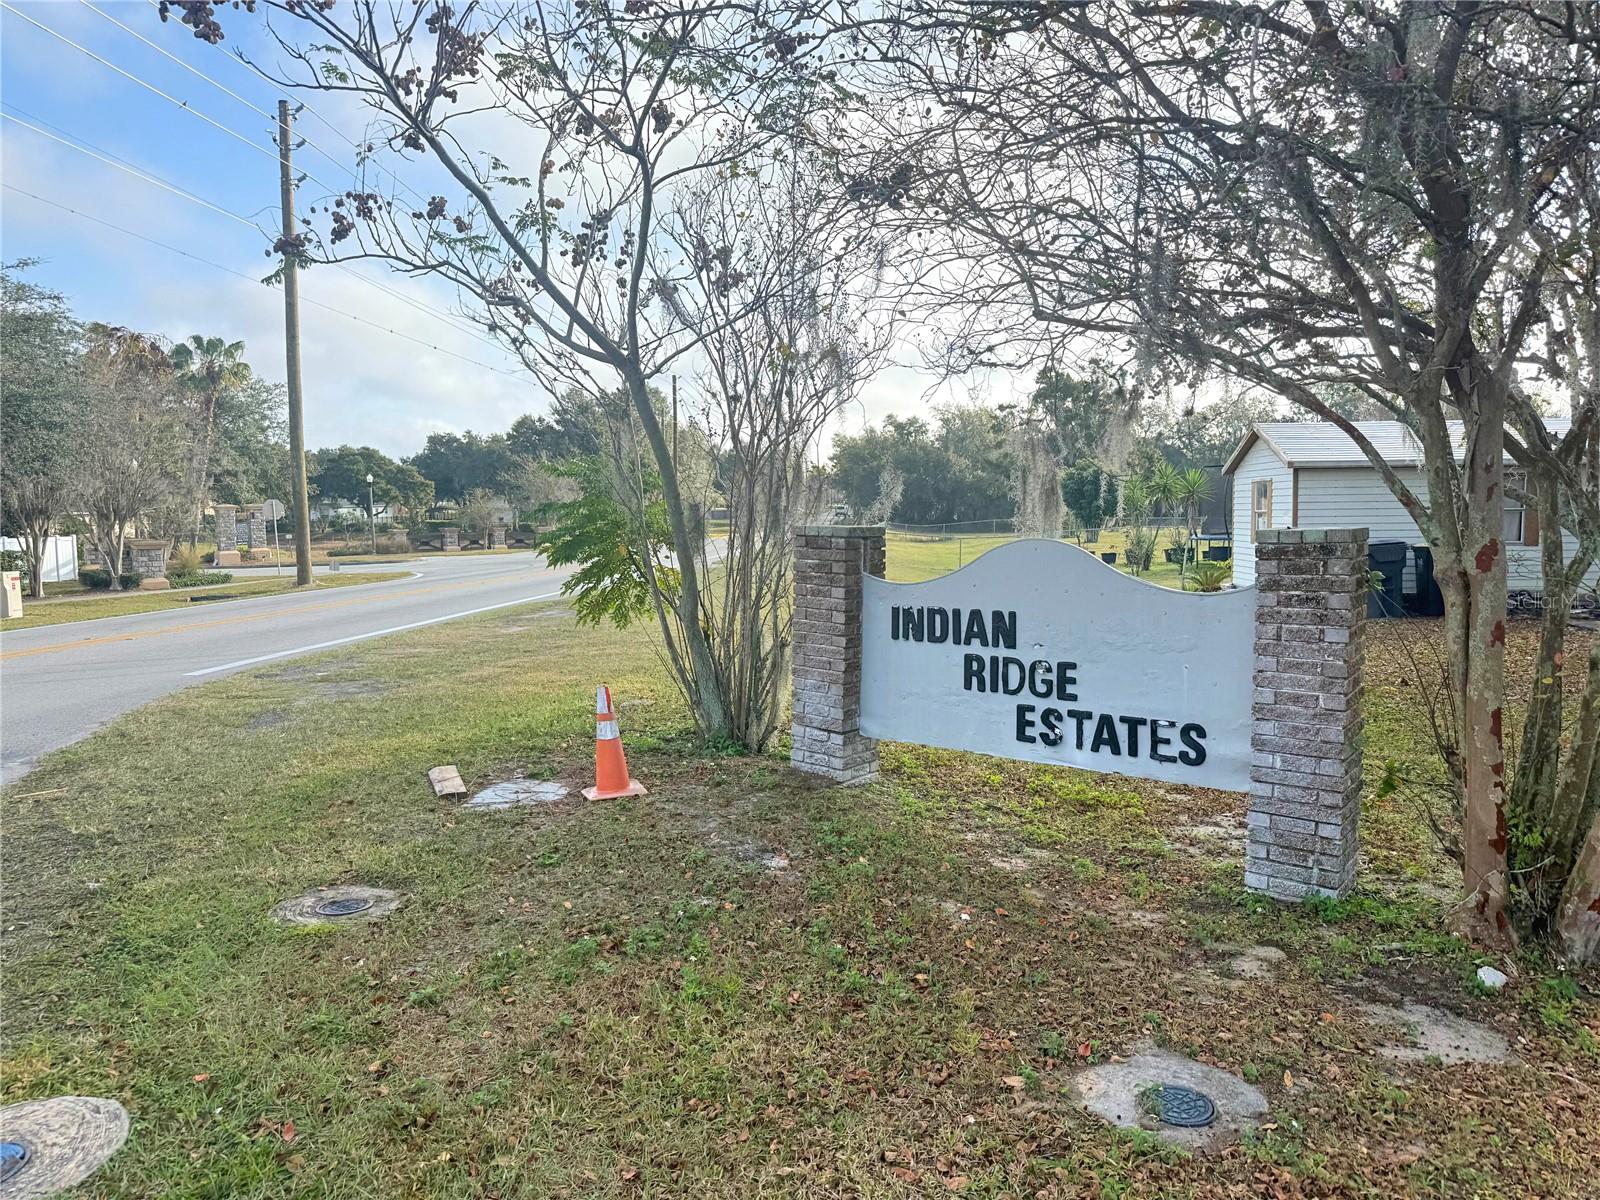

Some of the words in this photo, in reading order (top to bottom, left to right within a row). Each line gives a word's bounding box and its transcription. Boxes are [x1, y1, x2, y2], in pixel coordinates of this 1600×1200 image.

[890, 605, 1017, 649] INDIAN
[963, 653, 1078, 702] RIDGE
[1016, 703, 1207, 766] ESTATES
